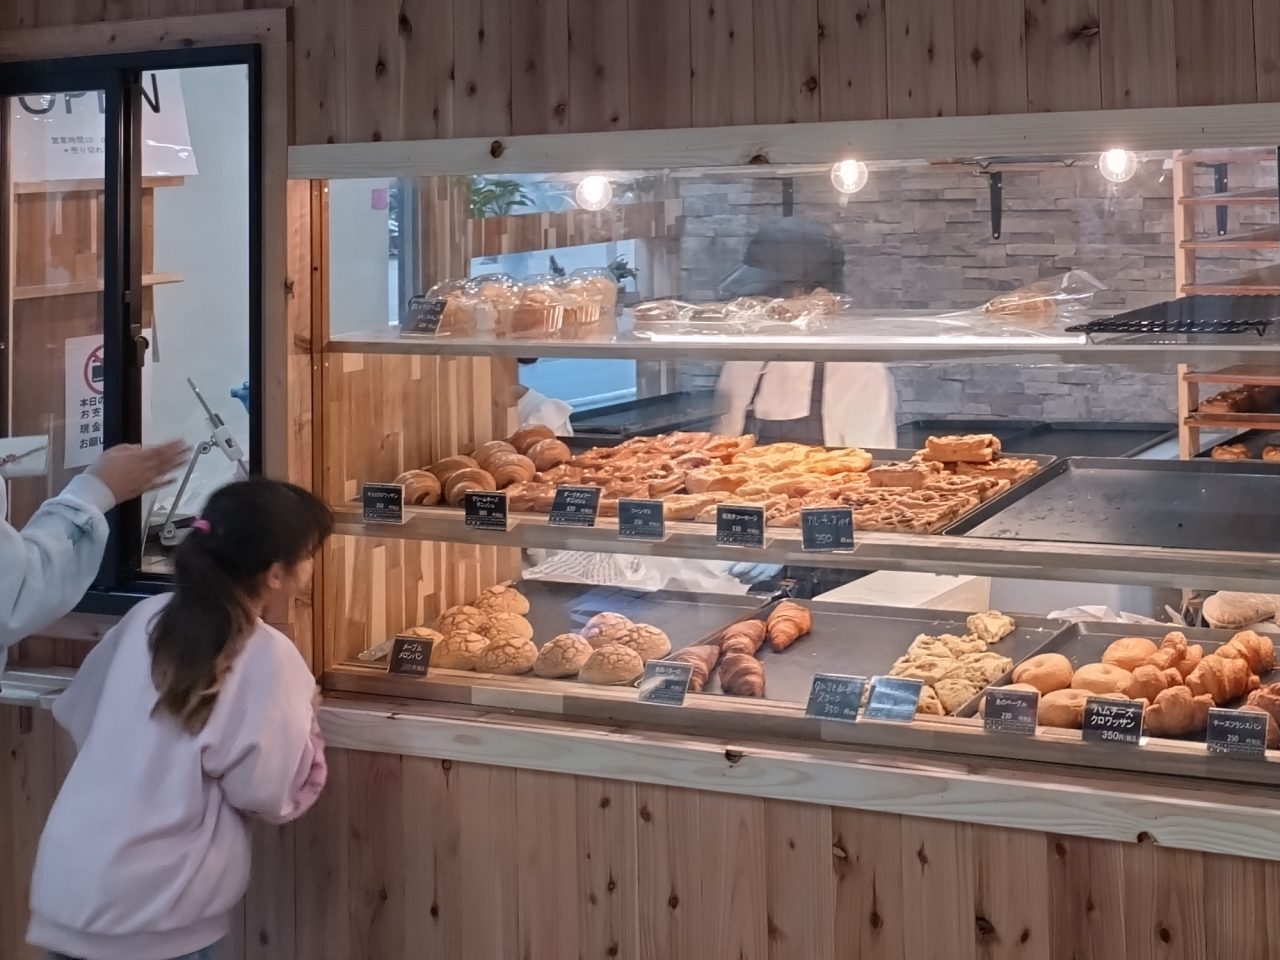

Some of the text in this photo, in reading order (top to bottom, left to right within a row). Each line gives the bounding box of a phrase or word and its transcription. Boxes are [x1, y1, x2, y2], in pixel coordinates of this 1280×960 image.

[1093, 705, 1134, 717] ハムチーズ
[1091, 715, 1135, 728] クロワッサン
[1213, 720, 1262, 730] チーズフランスパン
